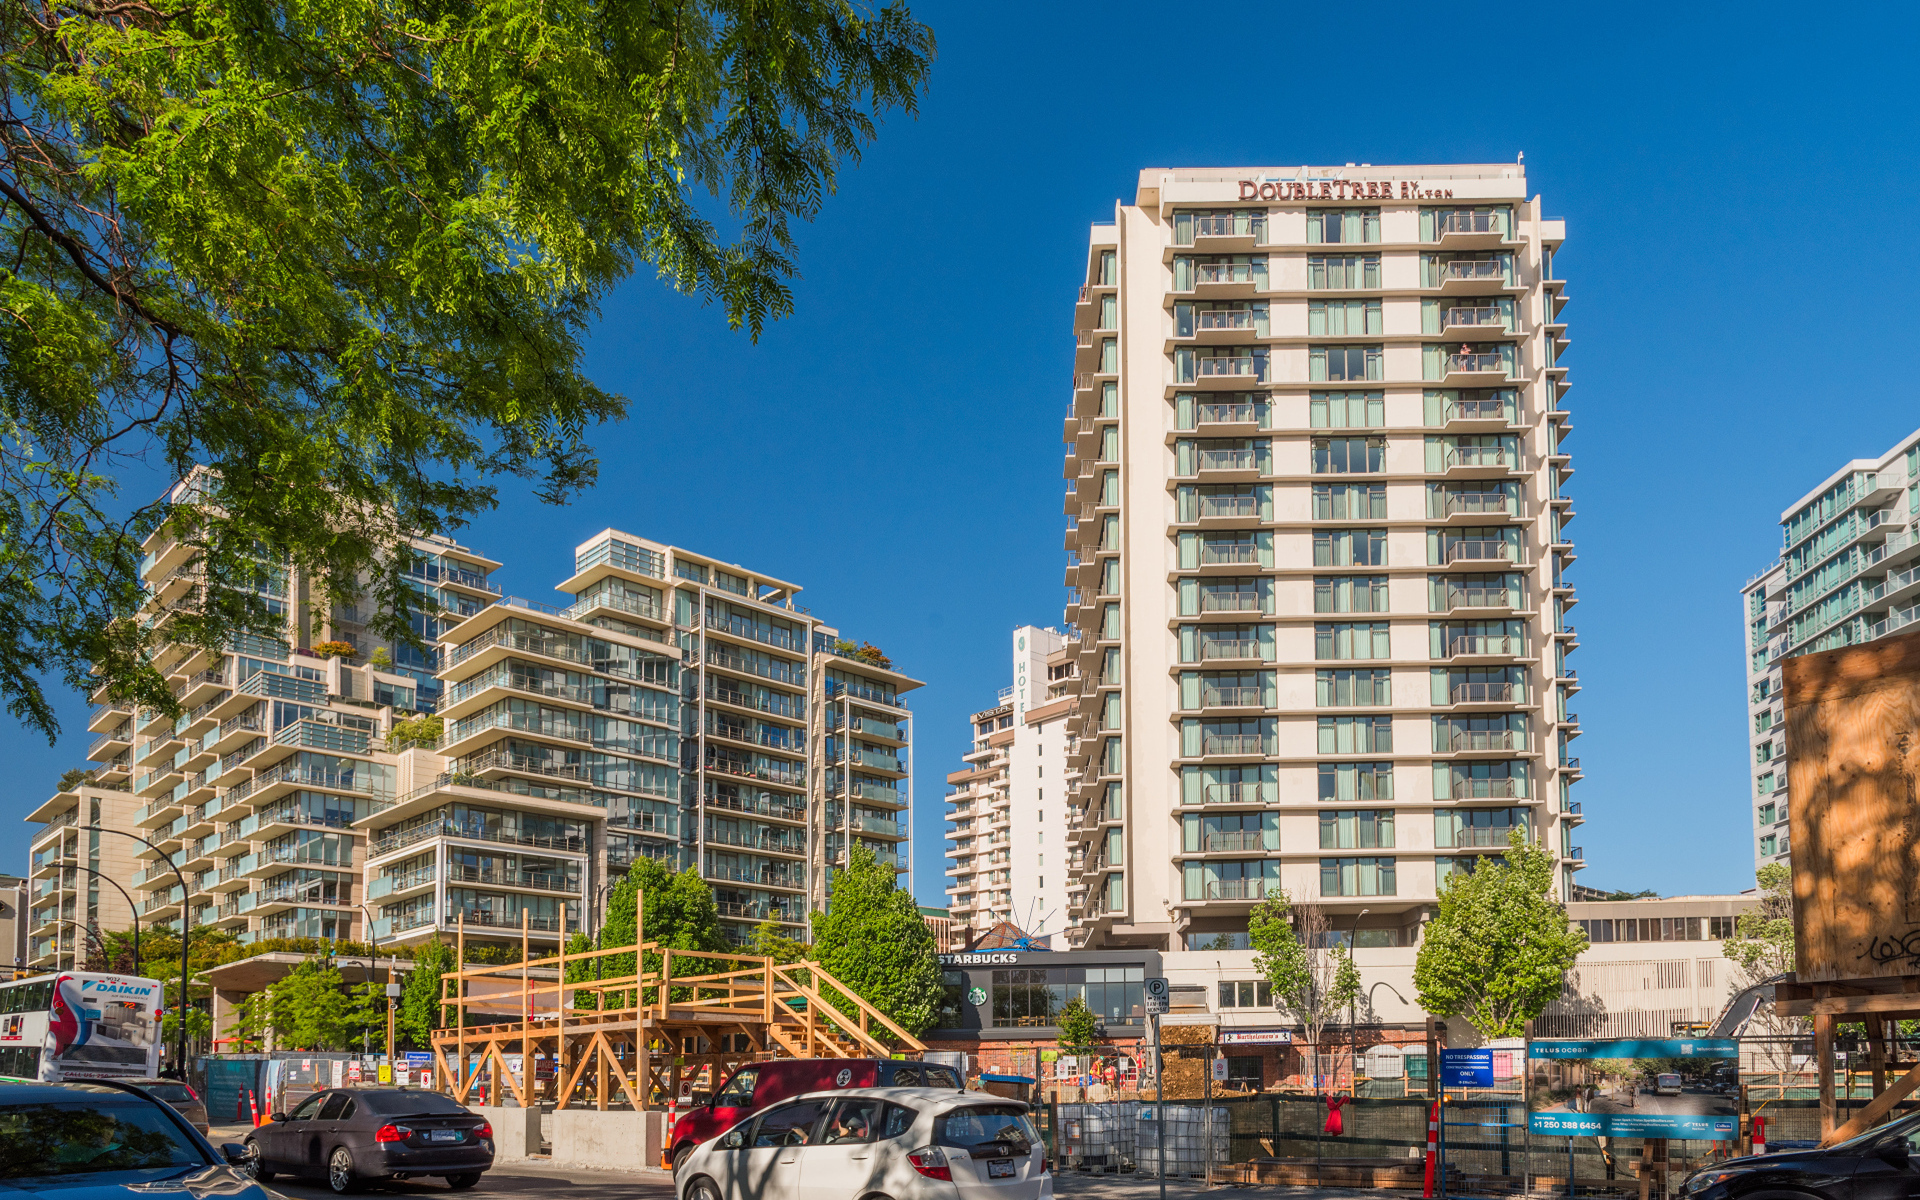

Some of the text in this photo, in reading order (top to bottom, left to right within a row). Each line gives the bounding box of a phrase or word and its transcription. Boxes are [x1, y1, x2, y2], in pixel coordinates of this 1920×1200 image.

[1401, 181, 1418, 190] BY
[1401, 189, 1453, 199] HILTON
[1018, 661, 1026, 727] HOTEL
[977, 705, 1010, 719] VISTA
[938, 953, 1018, 964] STARBUCKS
[96, 983, 151, 996] DAIKIN
[1153, 983, 1161, 992] P
[123, 1001, 136, 1009] 72
[1561, 1121, 1578, 1129] 388
[1579, 1122, 1602, 1130] 6454
